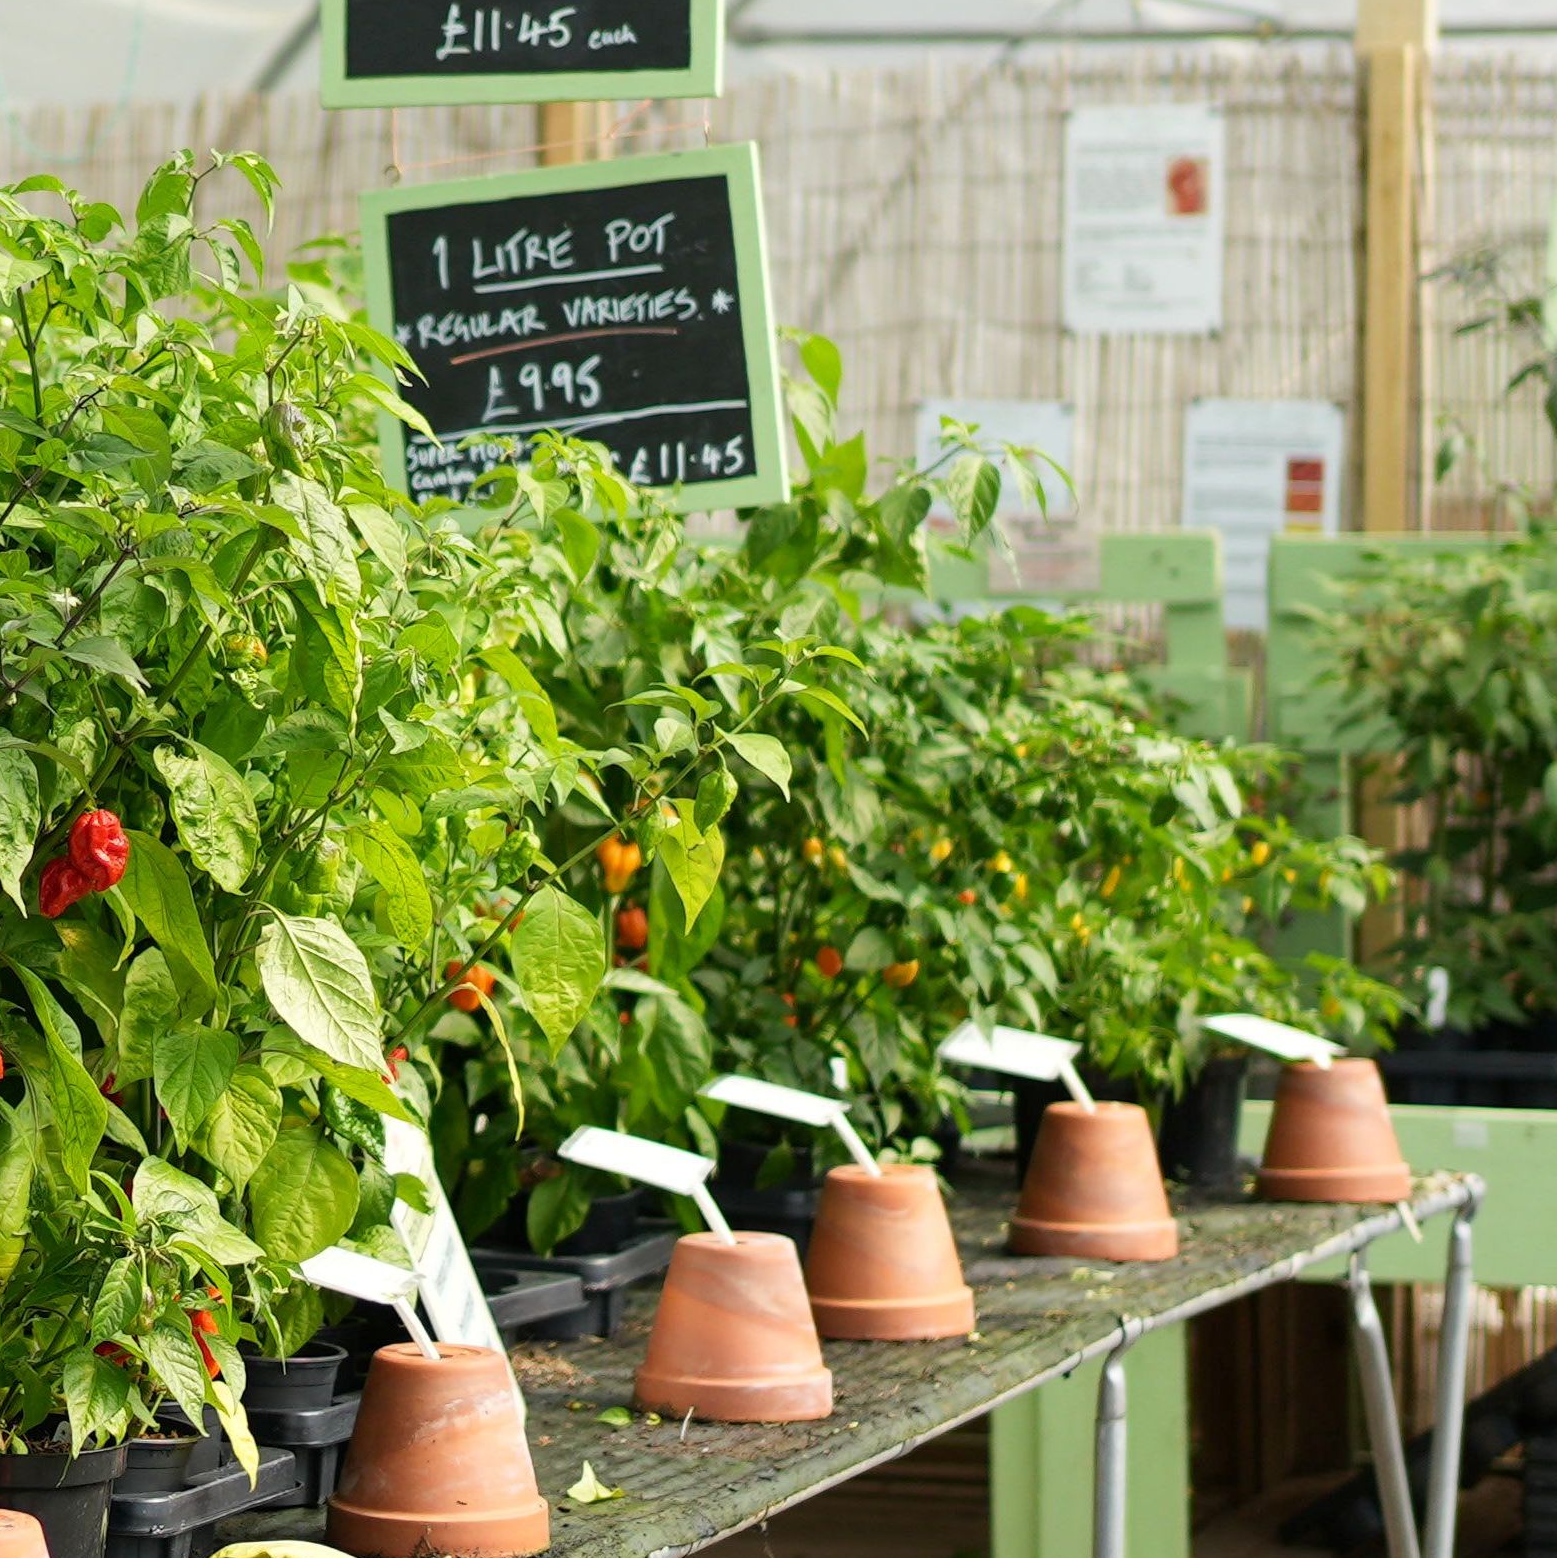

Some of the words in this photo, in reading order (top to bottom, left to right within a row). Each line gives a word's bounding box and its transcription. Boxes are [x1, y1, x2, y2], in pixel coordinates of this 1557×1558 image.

[589, 25, 637, 50] each
[432, 235, 449, 289] 1
[472, 227, 574, 279] LITRE
[605, 212, 676, 263] POT
[482, 353, 603, 424] £9.95
